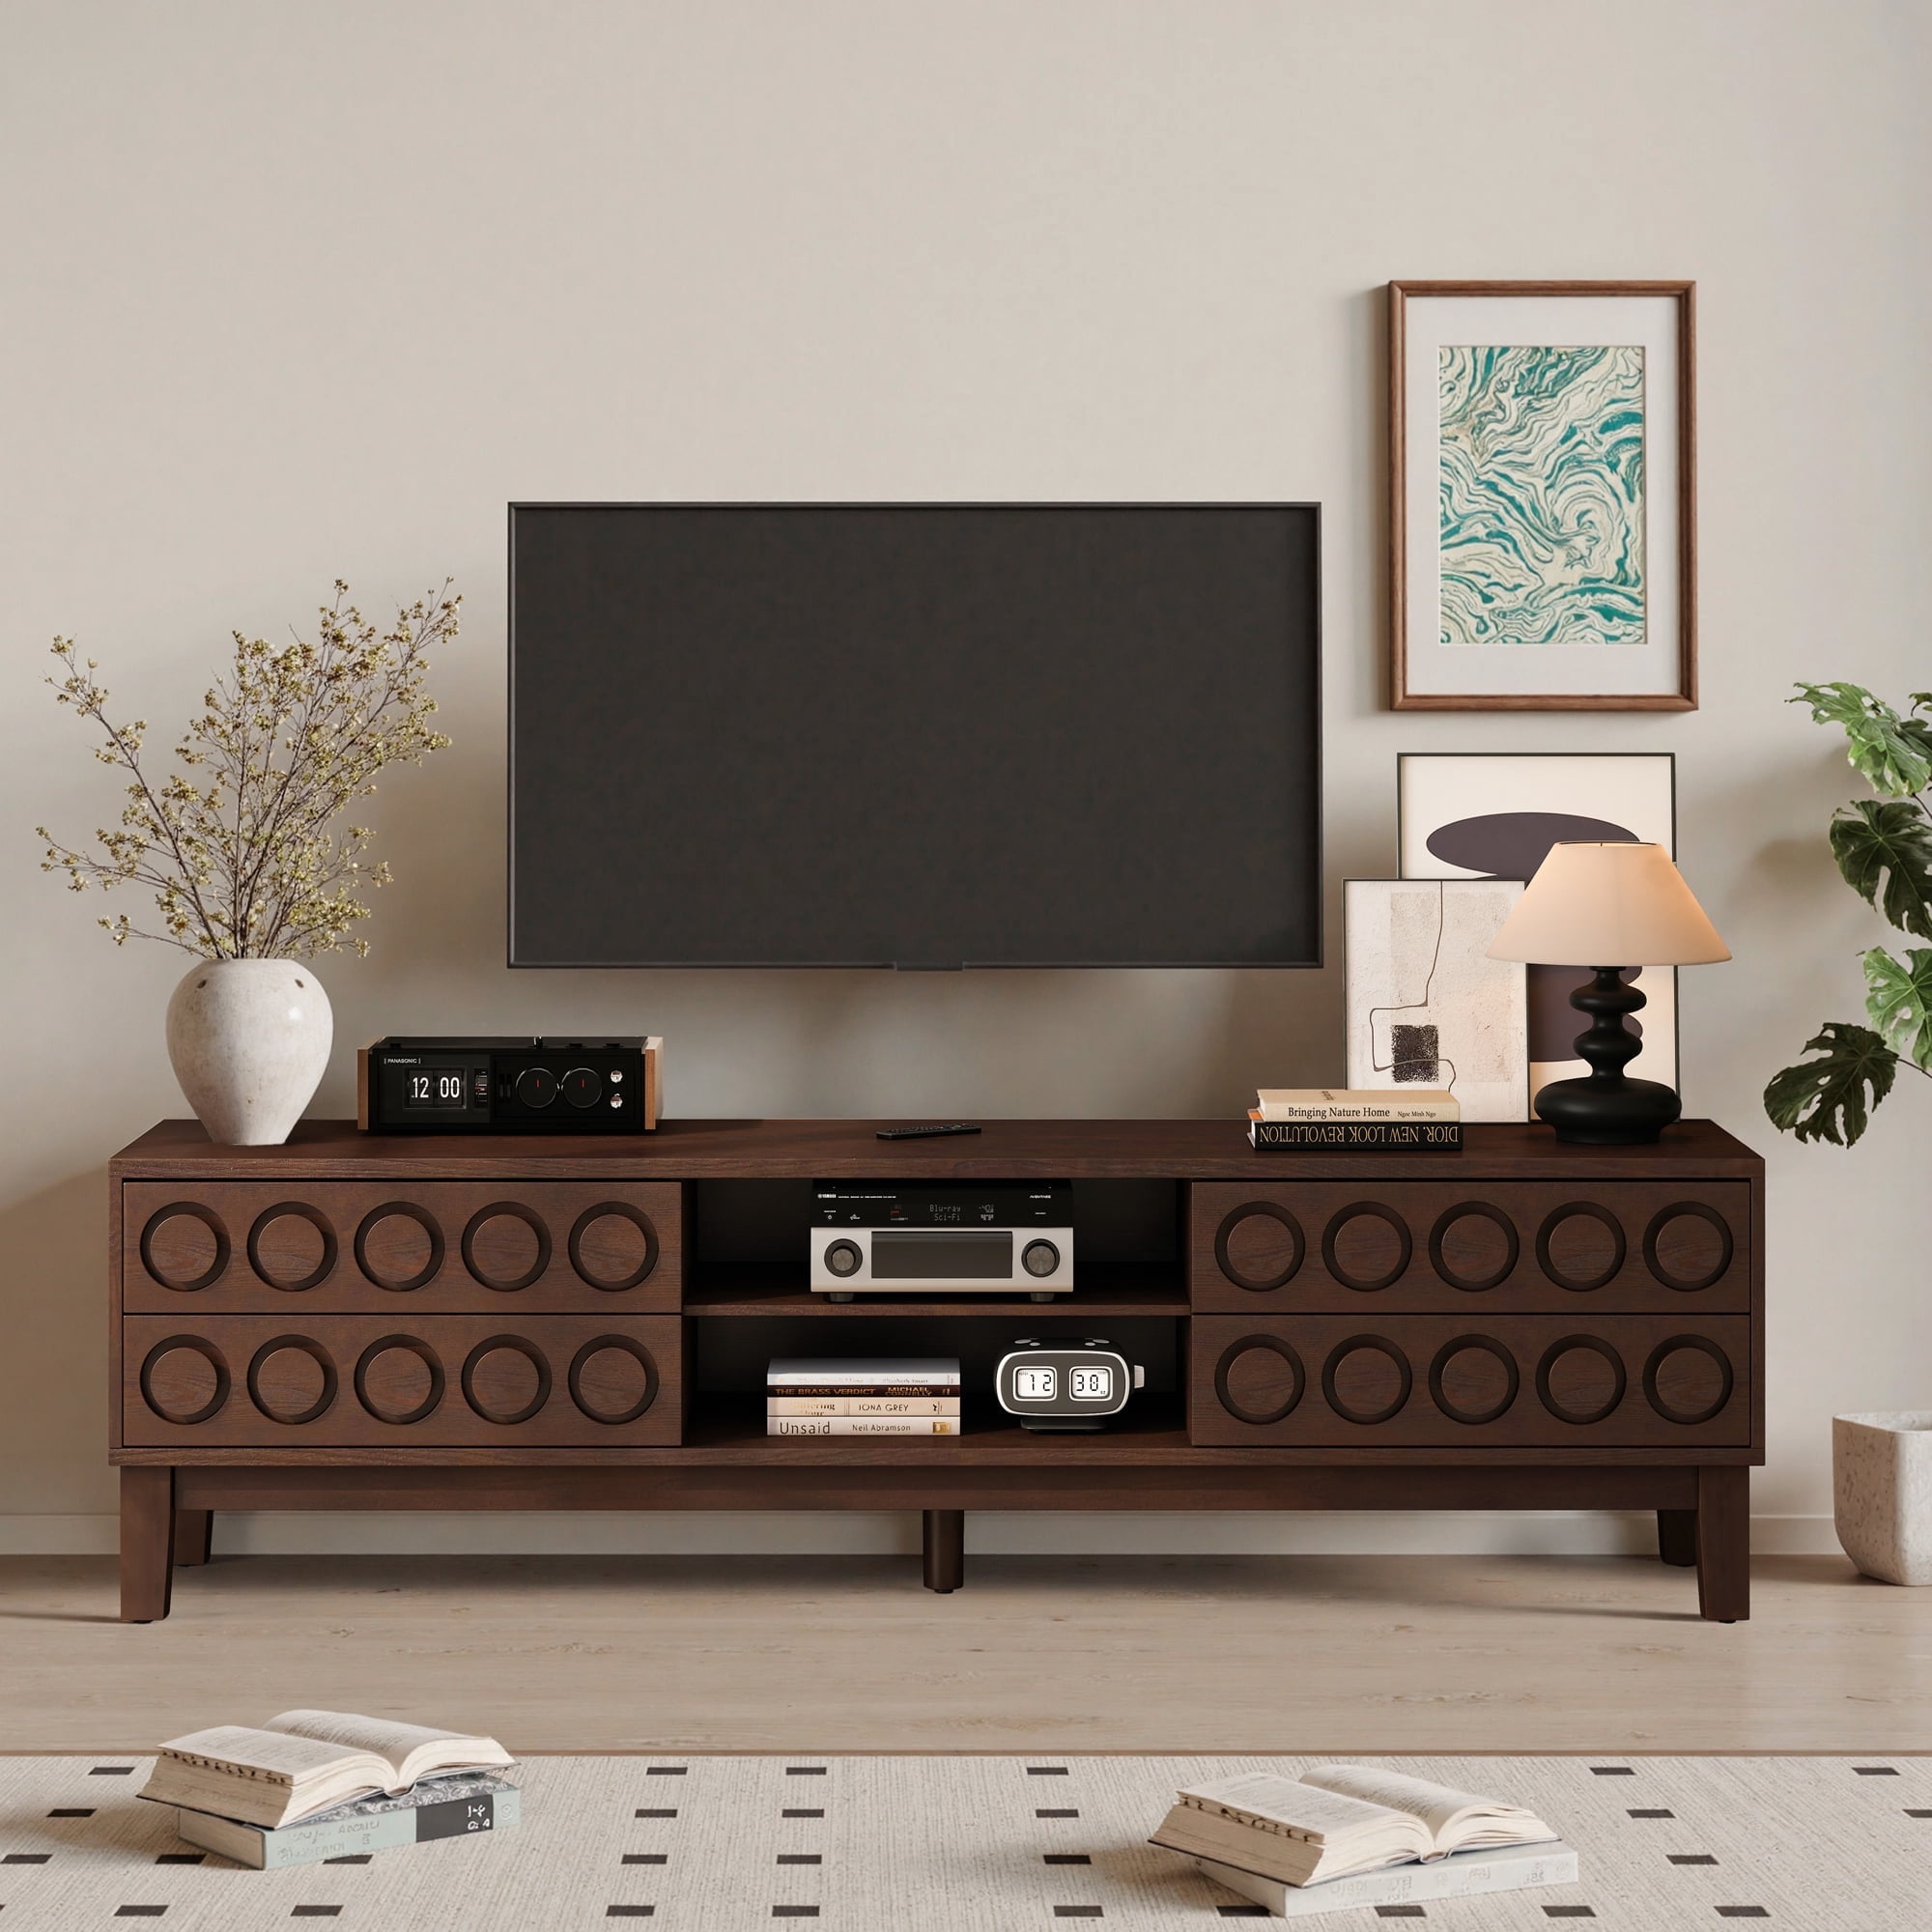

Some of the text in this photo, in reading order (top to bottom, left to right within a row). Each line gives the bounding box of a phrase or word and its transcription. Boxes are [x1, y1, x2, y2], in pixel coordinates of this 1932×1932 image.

[412, 1076, 461, 1098] 12 00
[1288, 1106, 1391, 1121] Bringing Nature Home
[1397, 1110, 1410, 1119] Ngoc
[1425, 1110, 1436, 1119] Ngo
[1259, 1125, 1346, 1143] REVOLUTION
[1349, 1125, 1386, 1143] LOOK
[1388, 1125, 1420, 1143] NEW
[929, 1204, 961, 1213] Blu-ray
[1029, 1374, 1099, 1392] 12 30
[858, 1404, 909, 1412] IONA GREY
[779, 1421, 831, 1435] Unsaid
[852, 1423, 911, 1432] Neil Abramson
